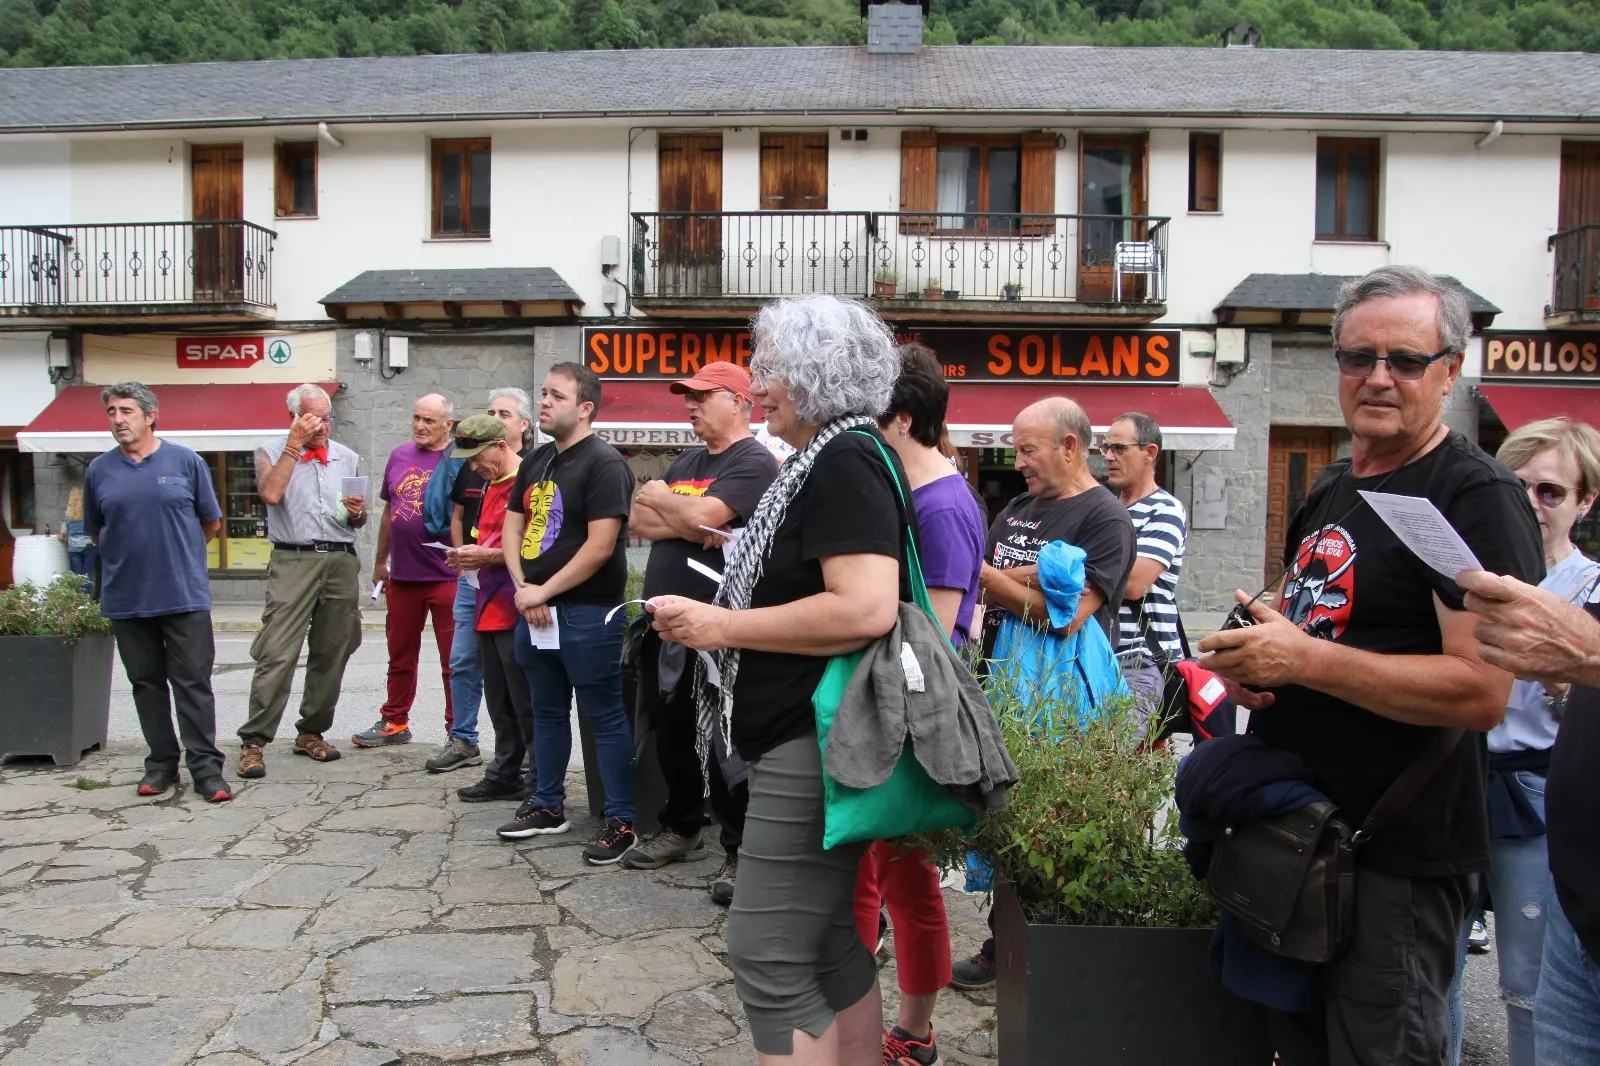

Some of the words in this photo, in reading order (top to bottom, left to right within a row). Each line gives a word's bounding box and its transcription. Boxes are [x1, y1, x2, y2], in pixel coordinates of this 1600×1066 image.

[895, 332, 921, 345] AVE
[186, 344, 258, 360] SPAR
[987, 334, 1170, 377] SOLANS
[1487, 340, 1597, 373] POLLOS
